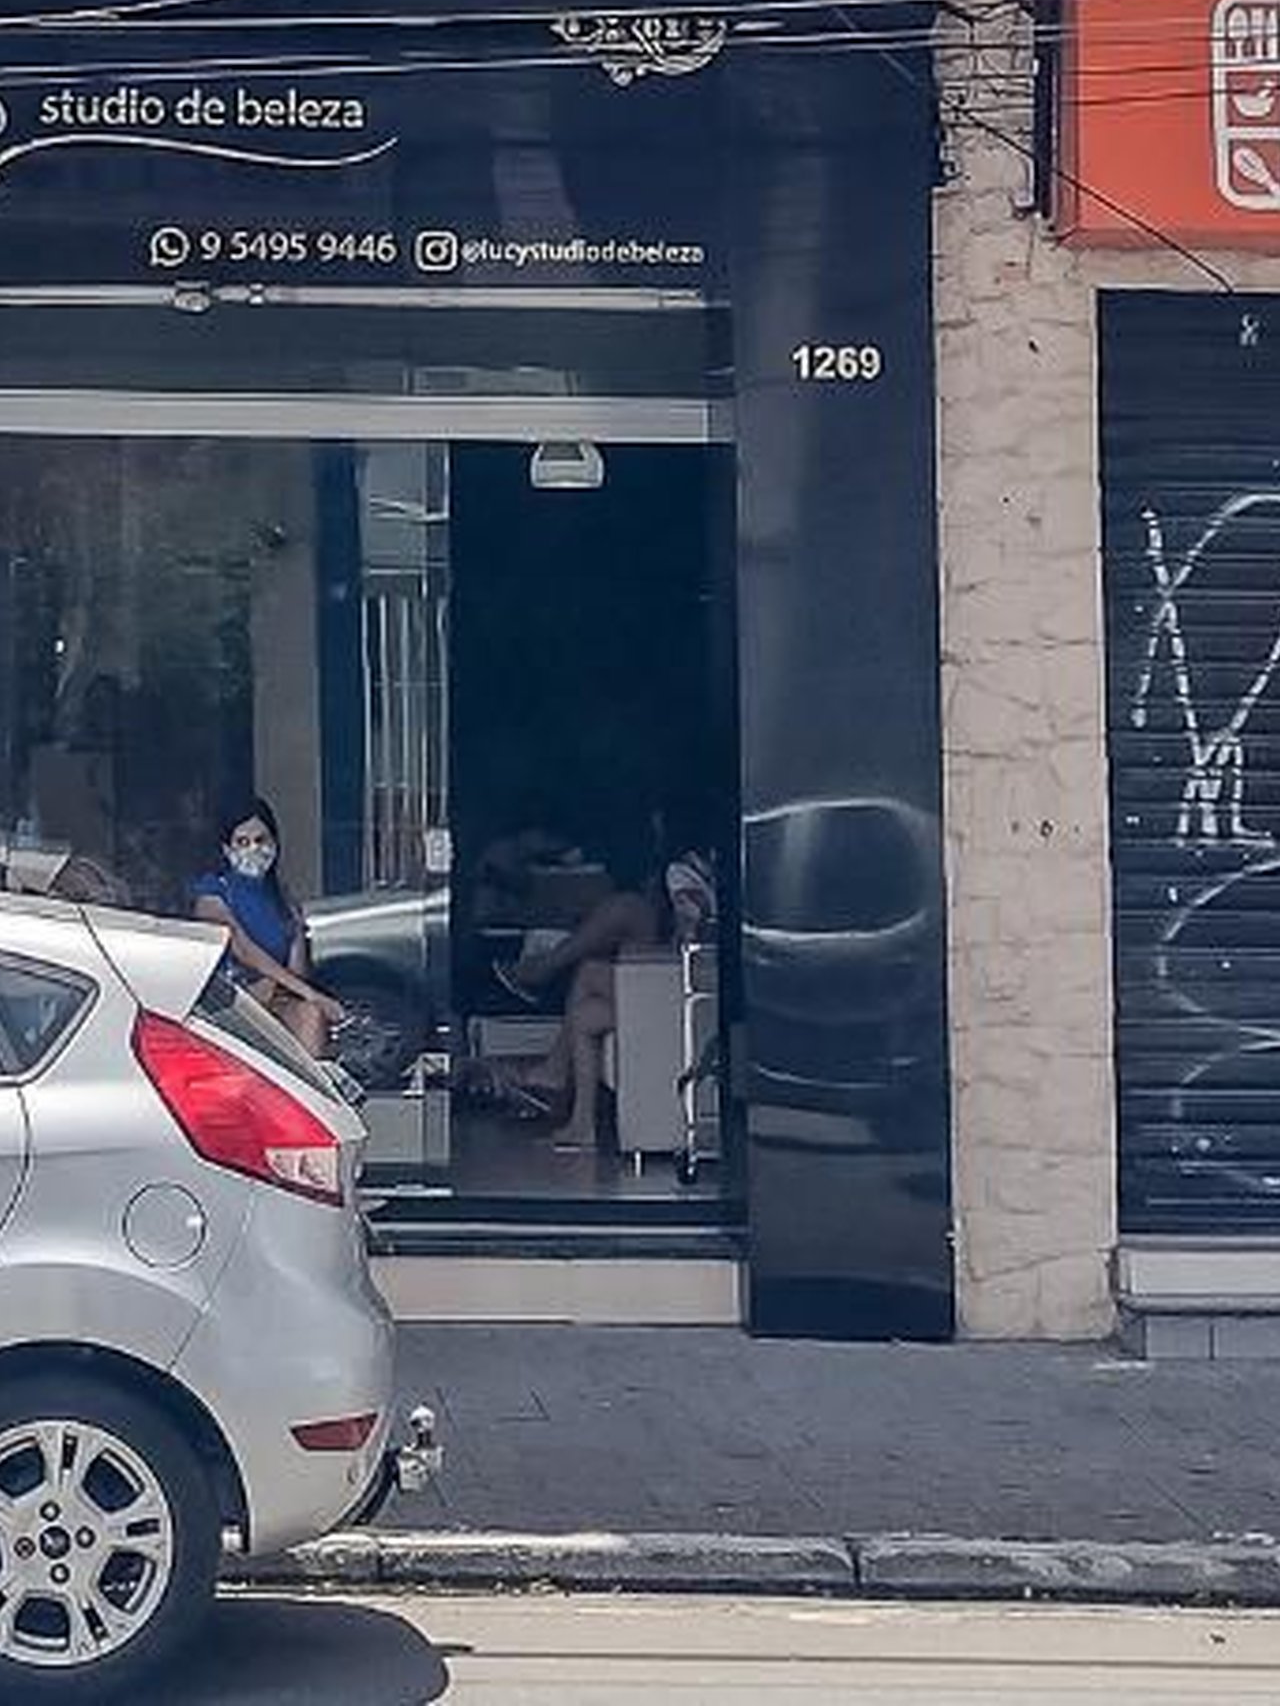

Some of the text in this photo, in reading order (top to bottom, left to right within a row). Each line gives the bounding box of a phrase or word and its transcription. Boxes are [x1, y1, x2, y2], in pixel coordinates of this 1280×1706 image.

[39, 86, 365, 128] studio de beleza
[200, 231, 221, 261] 9
[229, 231, 308, 262] 5495
[316, 232, 398, 263] 9446
[792, 345, 881, 380] 1269
